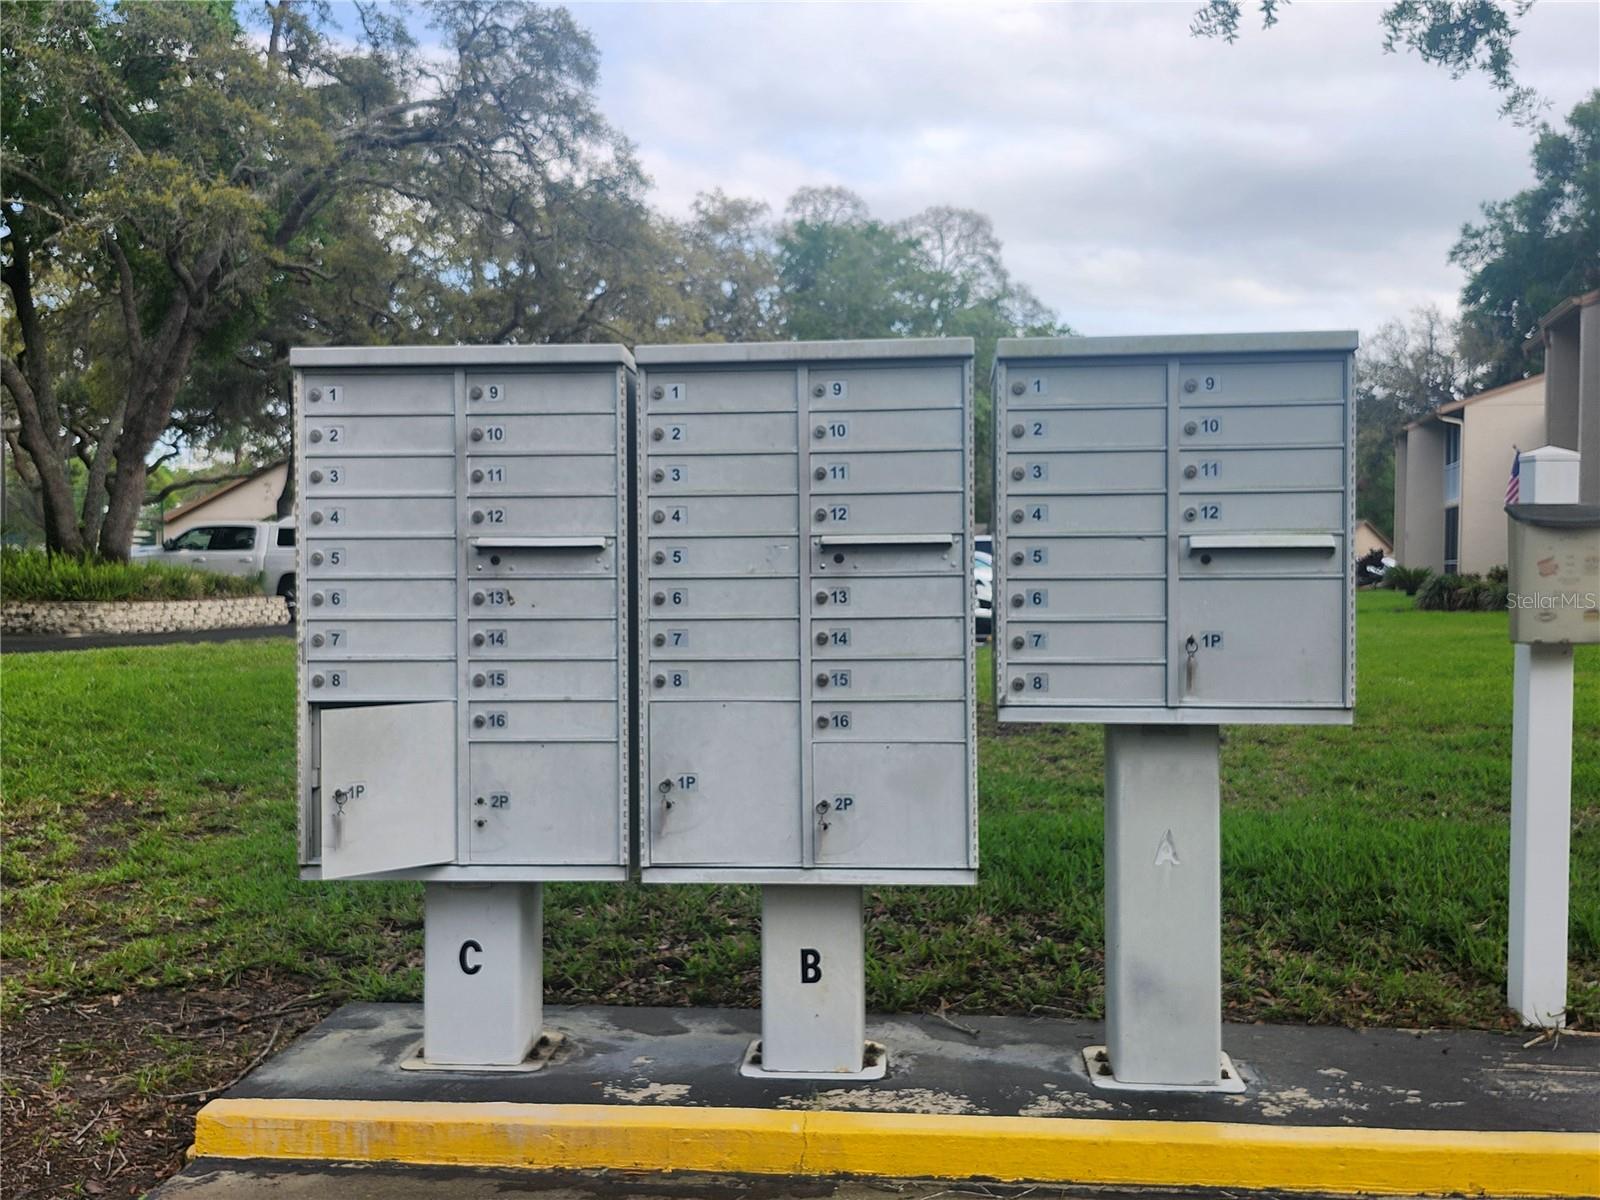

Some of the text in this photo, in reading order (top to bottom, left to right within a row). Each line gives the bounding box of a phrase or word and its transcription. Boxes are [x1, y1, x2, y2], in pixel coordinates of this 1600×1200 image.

[832, 382, 842, 396] 9
[1032, 379, 1041, 393] 1
[1205, 376, 1215, 391] 9
[328, 387, 336, 402] 1
[489, 385, 499, 400] 9
[671, 385, 679, 399] 1
[671, 426, 681, 441] 2
[829, 424, 846, 438] 10
[1033, 422, 1043, 436] 2
[1201, 419, 1219, 433] 10
[329, 428, 339, 443] 2
[486, 427, 503, 441] 10
[330, 469, 339, 483] 3
[487, 468, 502, 482] 11
[671, 468, 681, 482] 3
[829, 466, 845, 480] 11
[1032, 464, 1043, 479] 3
[1201, 462, 1218, 477] 11
[329, 510, 340, 524] 4
[487, 509, 504, 524] 12
[671, 509, 681, 523] 4
[830, 507, 847, 521] 12
[1031, 507, 1042, 521] 4
[1200, 505, 1219, 520] 12
[330, 551, 340, 565] 5
[672, 550, 682, 564] 5
[1032, 549, 1043, 564] 5
[331, 592, 341, 606] 6
[487, 590, 505, 605] 13
[672, 591, 682, 605] 6
[830, 589, 848, 604] 13
[1032, 591, 1042, 606] 6
[331, 632, 341, 647] 7
[488, 631, 505, 646] 14
[672, 632, 683, 646] 7
[831, 631, 848, 645] 14
[1032, 633, 1042, 648] 7
[1202, 634, 1221, 648] 1P
[331, 673, 341, 688] 8
[488, 672, 505, 687] 15
[672, 673, 682, 688] 8
[831, 672, 849, 687] 15
[1032, 676, 1043, 690] 8
[488, 713, 506, 728] 16
[831, 714, 849, 728] 16
[677, 775, 696, 790] 1P
[348, 784, 366, 800] 1P
[490, 794, 509, 809] 2P
[834, 797, 854, 811] 2P
[1154, 828, 1181, 866] A
[458, 939, 483, 975] C
[800, 947, 823, 984] B
